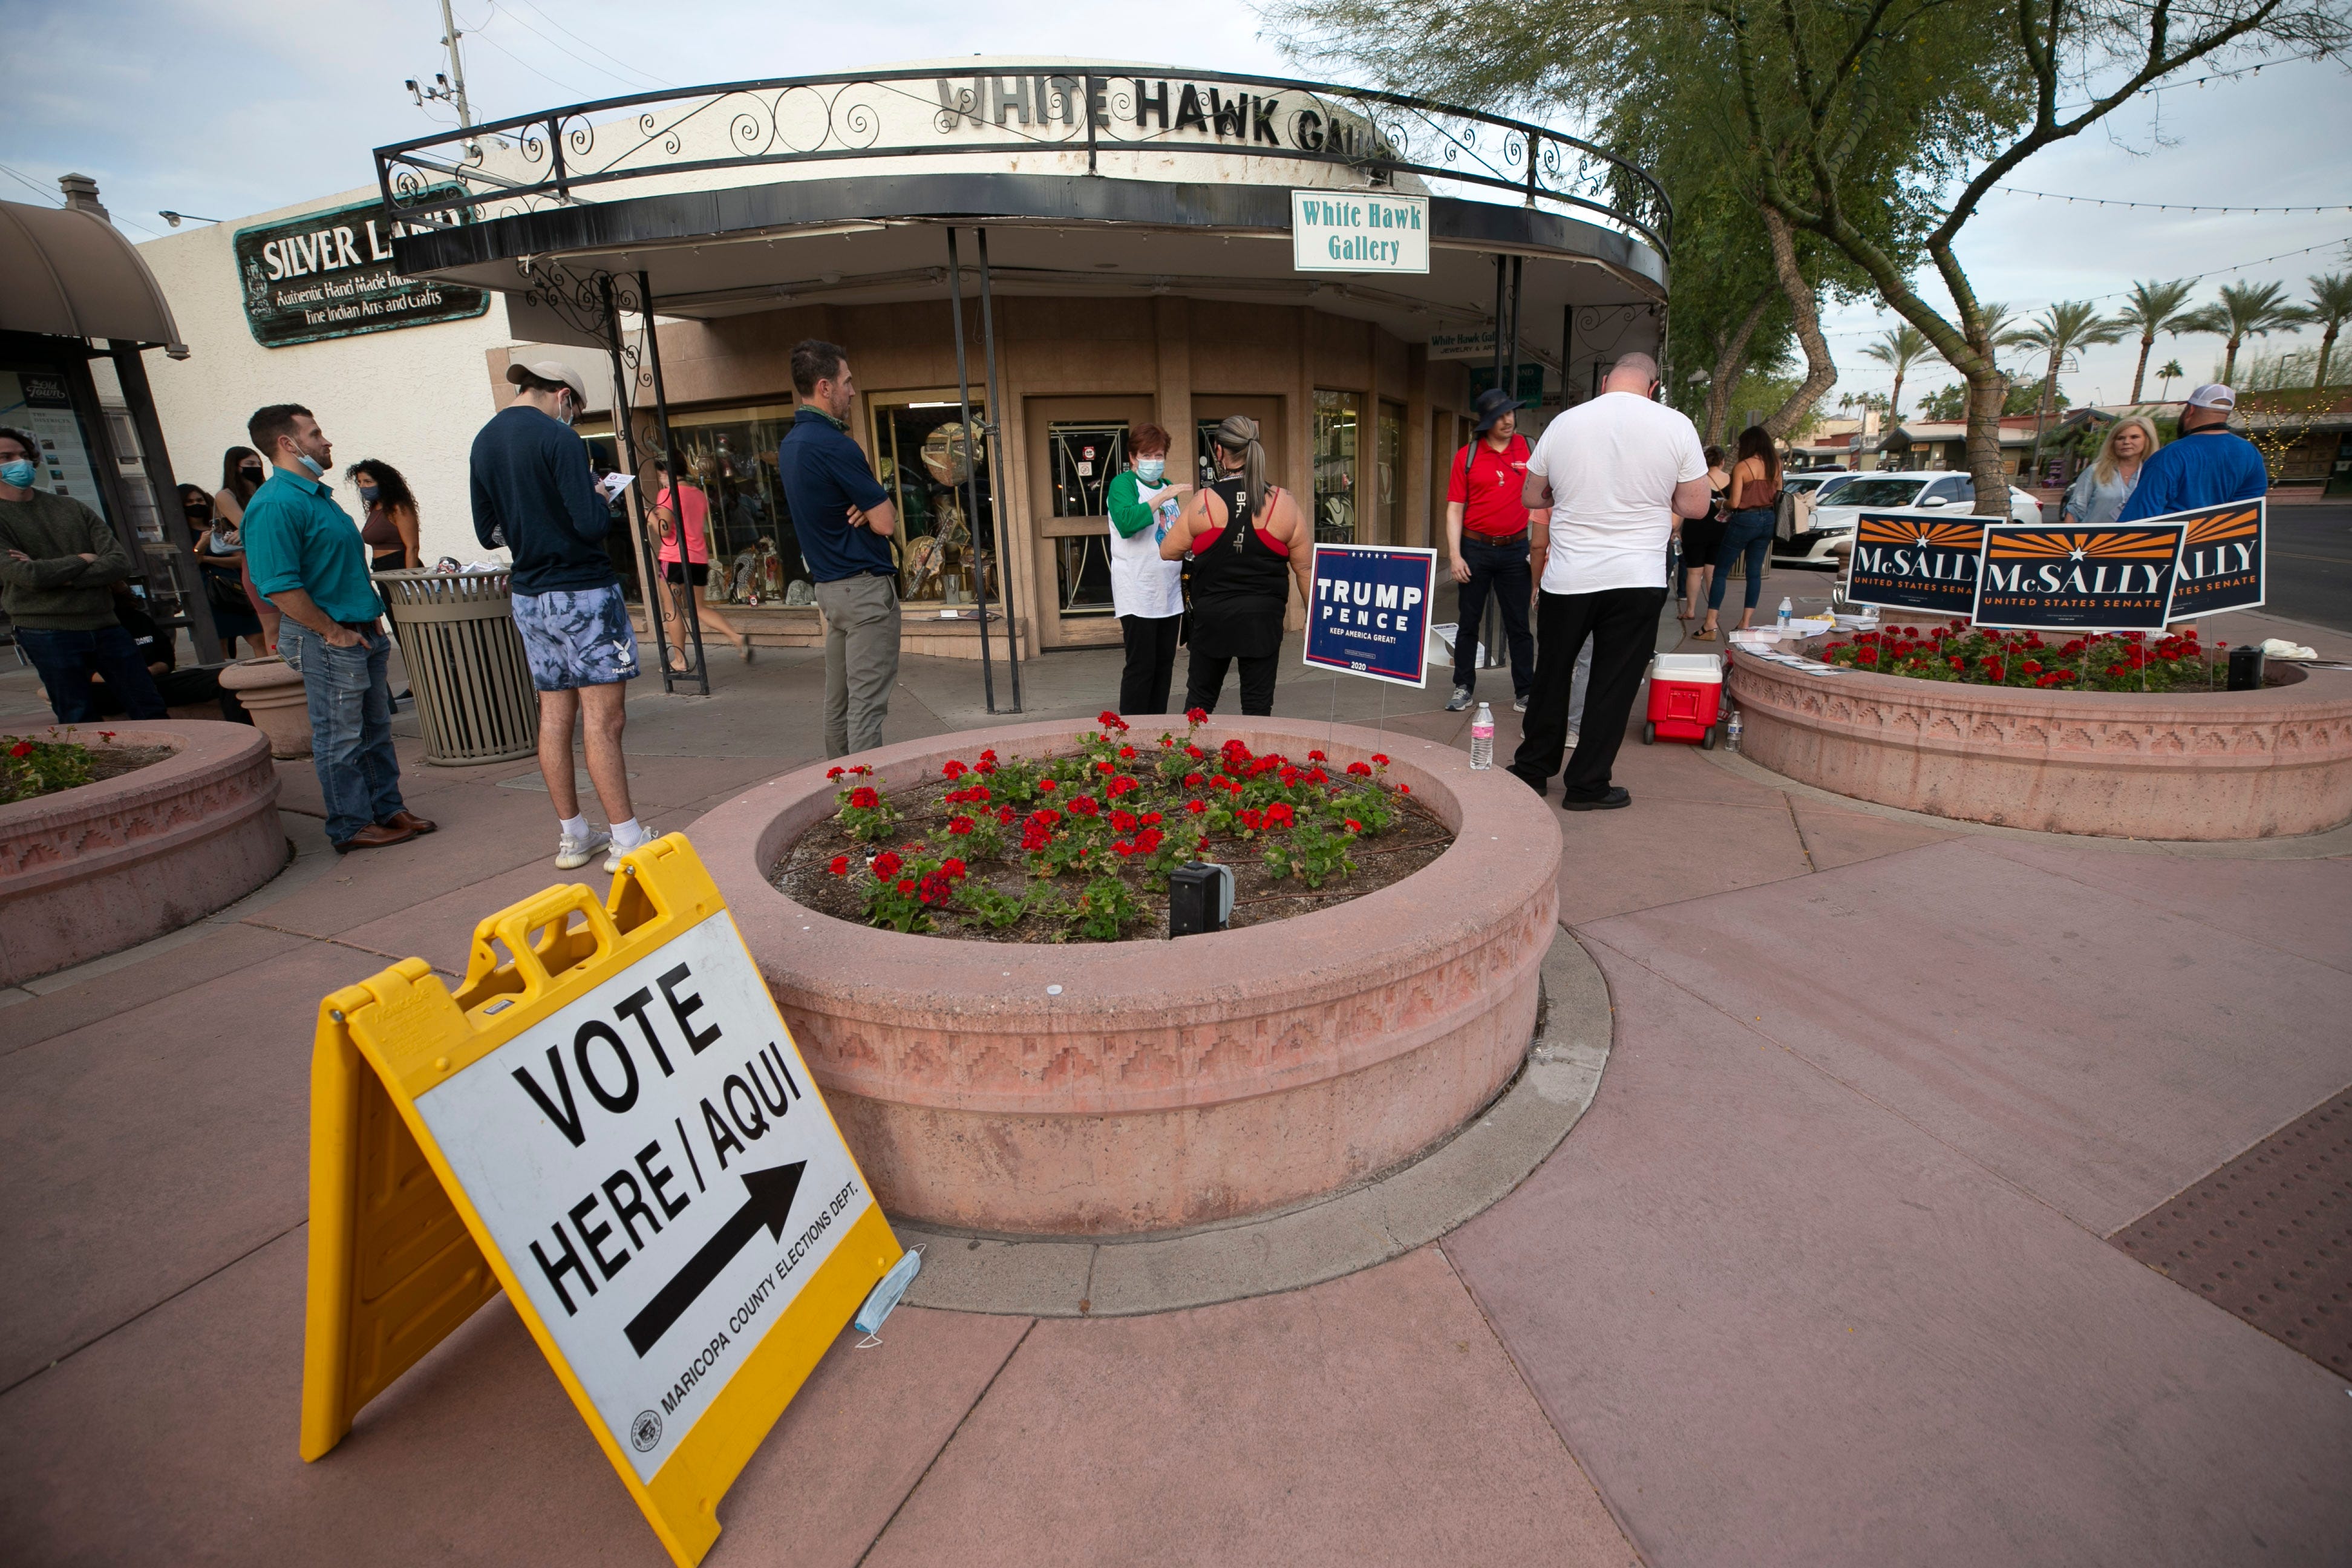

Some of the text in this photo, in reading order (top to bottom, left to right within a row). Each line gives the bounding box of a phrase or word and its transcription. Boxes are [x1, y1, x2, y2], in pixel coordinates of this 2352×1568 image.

[937, 76, 1109, 127] WHITE
[1135, 79, 1280, 145] HAWK
[1302, 201, 1421, 229] White Hawk
[263, 226, 362, 280] SILVER
[1328, 235, 1399, 265] Gallery
[277, 290, 324, 307] Authentic
[324, 279, 353, 298] Hand
[356, 274, 386, 293] Made
[305, 289, 442, 325] Fine Indian Arts and Crafts
[1431, 335, 1455, 346] White
[1457, 333, 1480, 344] Hawk
[26, 385, 66, 399] Town
[1855, 577, 1973, 594] UNITED STATES SENA
[1984, 564, 2171, 593] McSALLY
[2206, 575, 2256, 590] SENATE
[1317, 578, 1422, 610] TRUMP
[1984, 596, 2037, 606] UNITED
[2044, 598, 2096, 607] STATES
[2103, 599, 2161, 608] SENATE
[1322, 606, 1408, 632] PENCE
[1330, 627, 1396, 644] KEEP AMERICA GREAT!
[1351, 661, 1366, 671] 2020
[512, 962, 722, 1148] VOTE
[529, 1140, 691, 1317] HERE
[699, 1041, 802, 1172] AQUI
[661, 1181, 858, 1415] MARICOPA COUNTY ELECTIONS DEPT.
